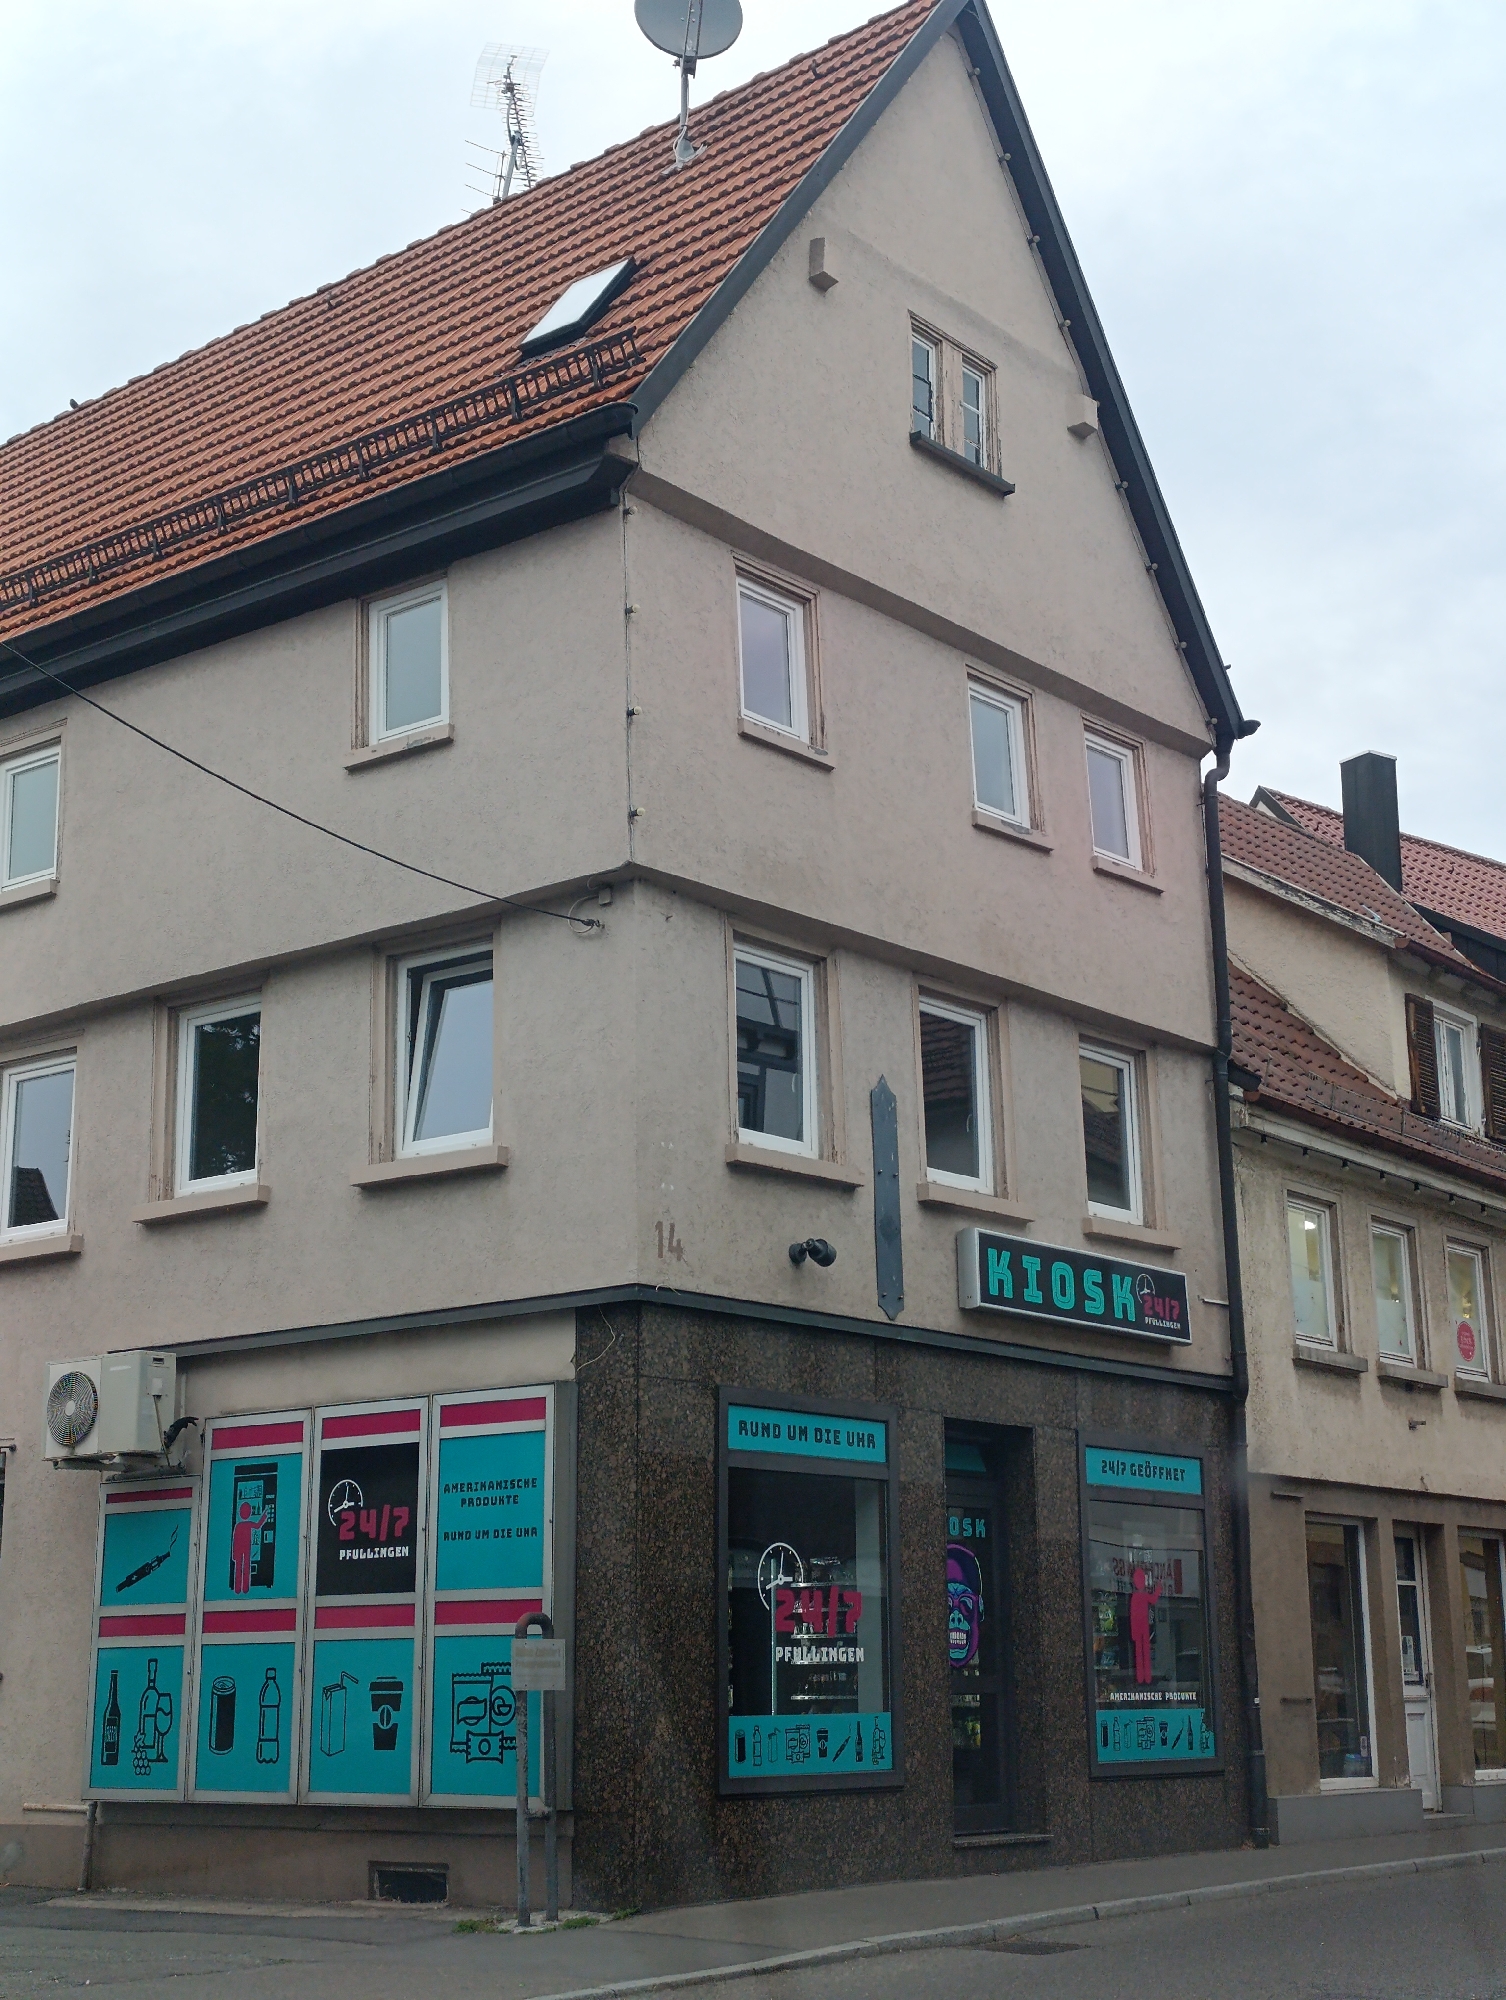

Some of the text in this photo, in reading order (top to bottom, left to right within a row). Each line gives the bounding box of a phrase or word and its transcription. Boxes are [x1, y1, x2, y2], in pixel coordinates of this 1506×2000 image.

[655, 1220, 684, 1261] 14
[987, 1247, 1136, 1322] KIOSK
[1143, 1294, 1181, 1321] 24/7
[1144, 1316, 1181, 1330] PFULLINGEN
[738, 1419, 876, 1449] RUND UM DIE UHR
[1101, 1459, 1186, 1482] 24/7 GEÖFFNET
[443, 1477, 538, 1494] AMERIKANISCHE
[460, 1494, 519, 1508] PRODUKTE
[339, 1504, 410, 1542] 24/7
[443, 1526, 538, 1541] RUND UM DIE UHR
[949, 1516, 986, 1538] OSK
[339, 1546, 409, 1560] PFULLINGEN
[774, 1585, 863, 1638] 24/7
[775, 1645, 865, 1662] PFULLINGEN
[1110, 1691, 1162, 1701] AMERIKANISCHE
